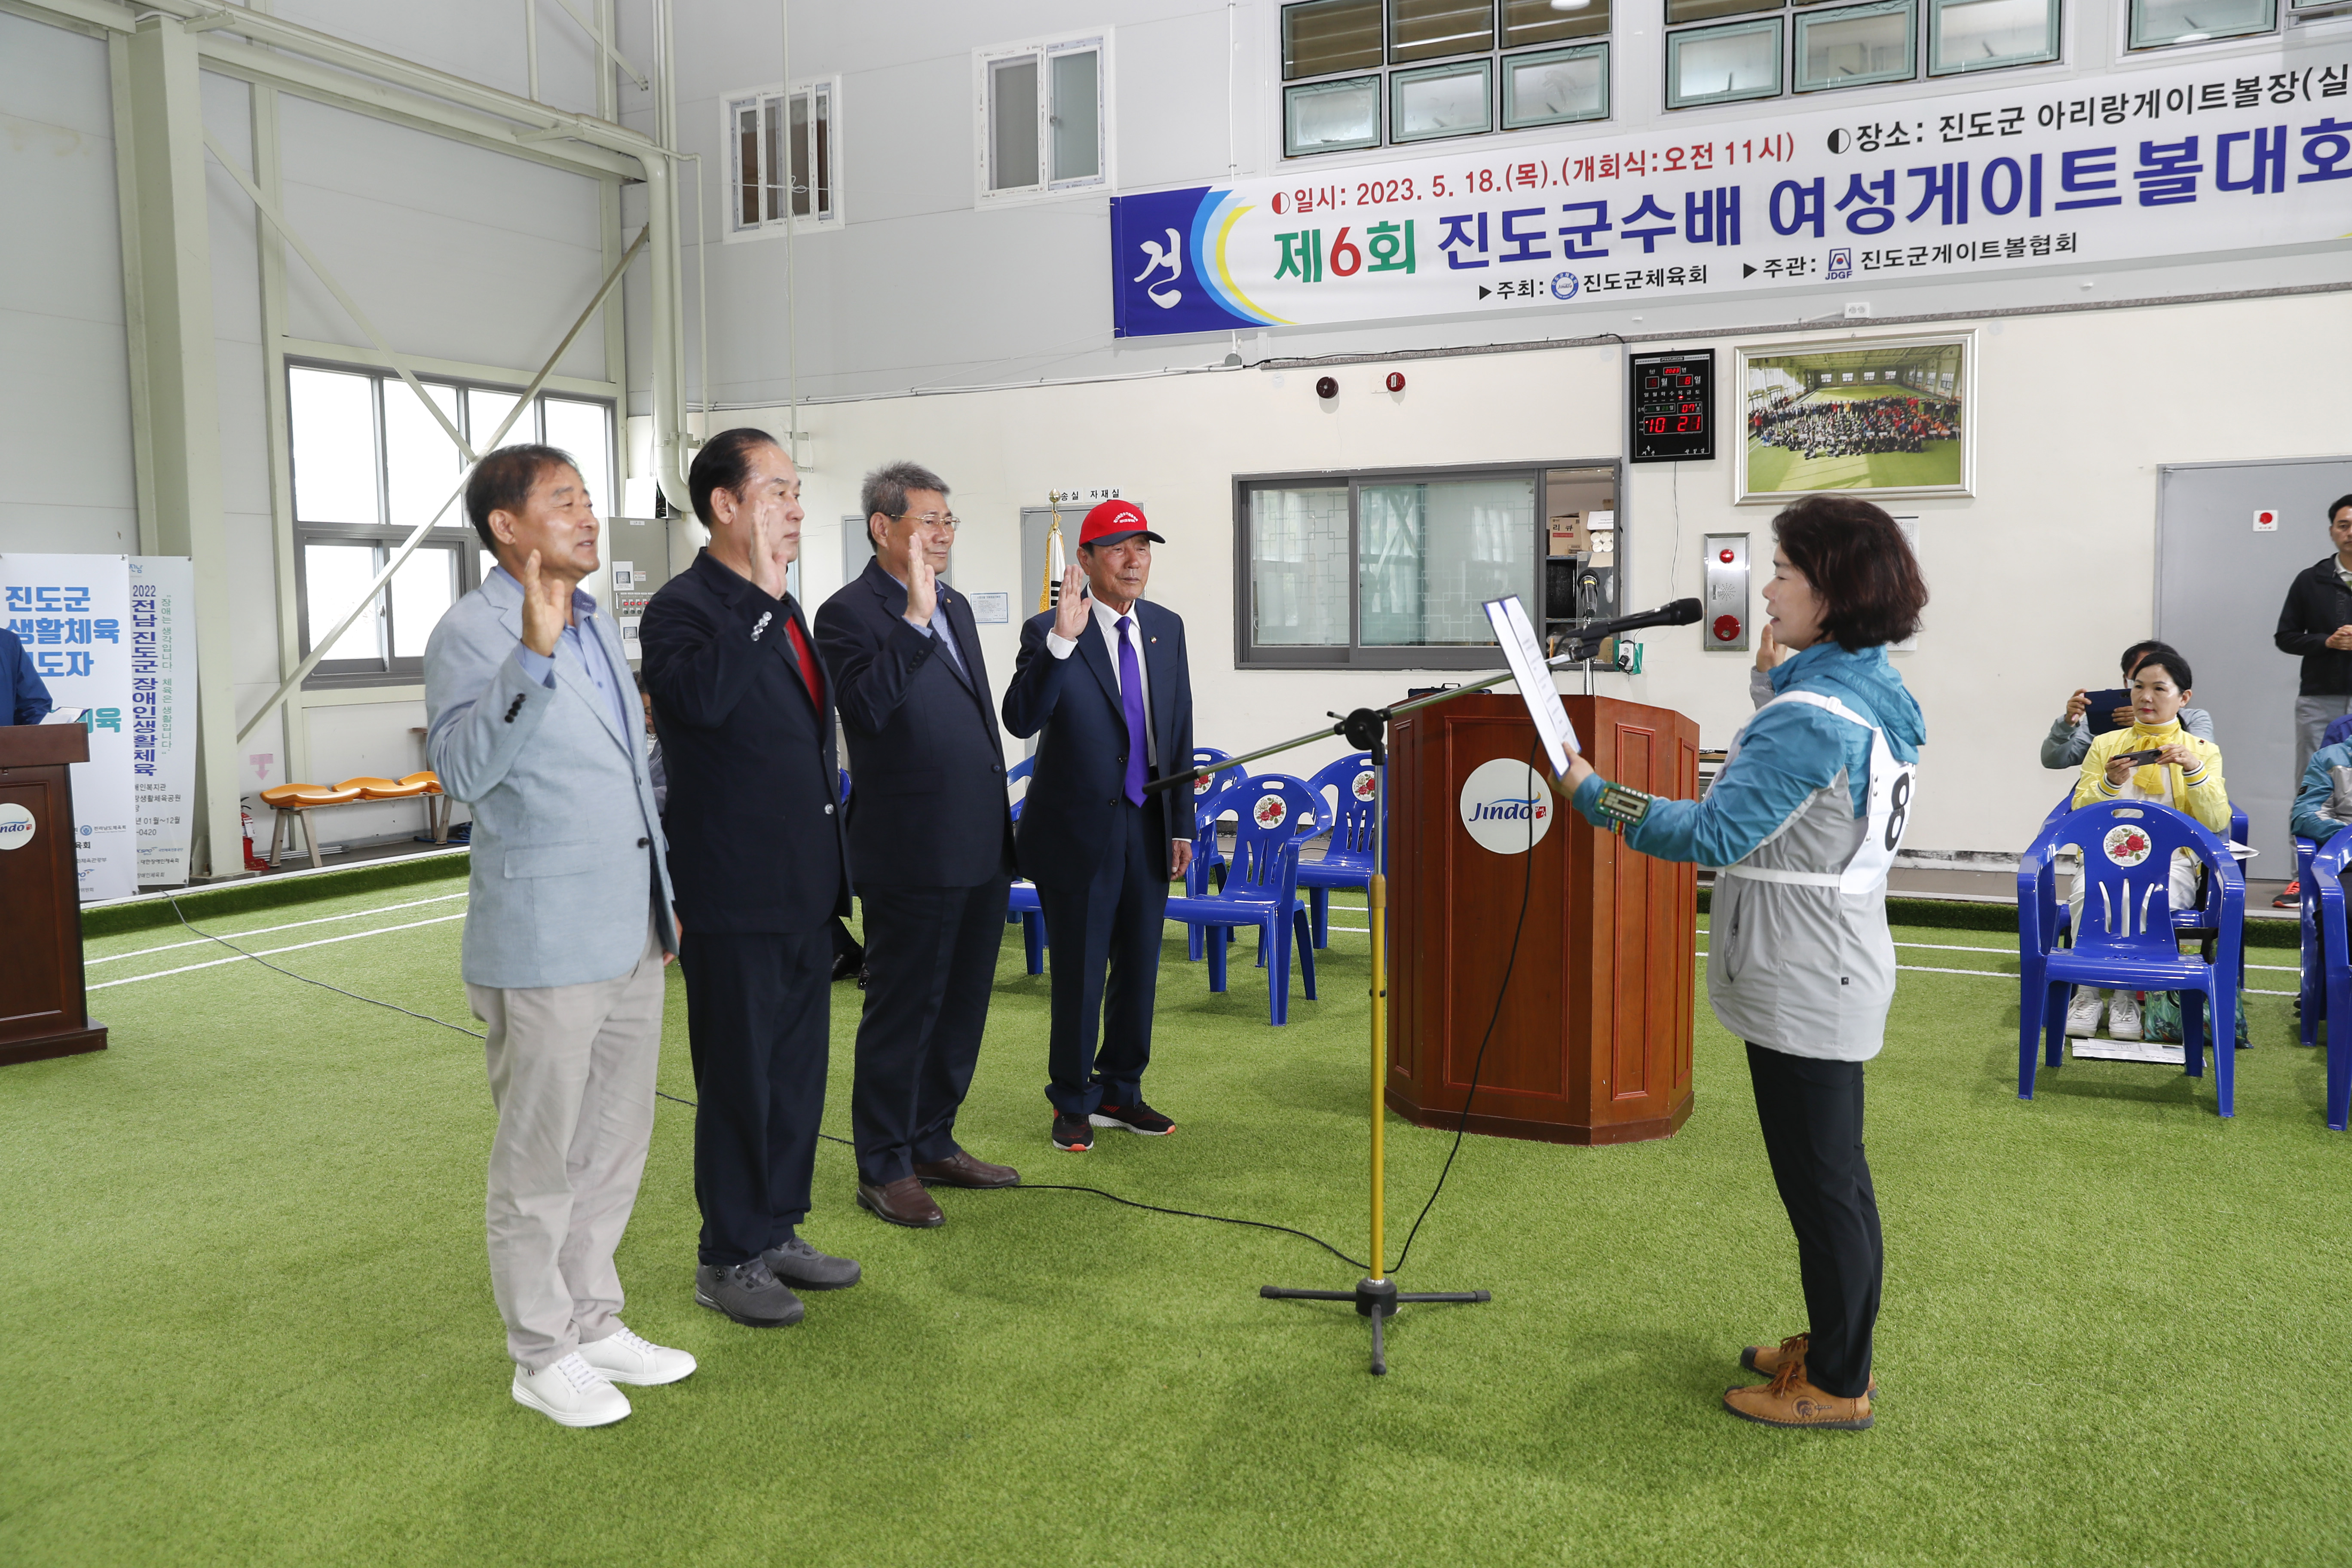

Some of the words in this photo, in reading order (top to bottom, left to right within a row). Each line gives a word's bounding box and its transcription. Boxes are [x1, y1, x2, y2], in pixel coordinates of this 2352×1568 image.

[1856, 122, 1923, 152] 장소:
[1939, 106, 2025, 143] 진도군
[1294, 185, 1346, 213] 일시:
[1357, 178, 1422, 205] 2023.
[1432, 175, 1454, 197] 5.
[1725, 132, 1794, 165] 11시)
[1273, 219, 1416, 283] 제6회
[1438, 185, 1740, 270] 진도군수배
[1763, 257, 1816, 279] 주관:
[1860, 232, 2077, 270] 진도군게이트볼협회
[1497, 279, 1544, 300] 주최:
[1583, 264, 1707, 293] 진도군체육회
[1825, 270, 1853, 280] JDGF
[1649, 417, 1666, 433] 10
[1677, 416, 1701, 432] 21
[6, 586, 91, 612] 진도군
[133, 585, 156, 597] 2022
[6, 618, 120, 644] 생활체육
[132, 600, 158, 627] 전남
[132, 631, 158, 673] 진도군
[132, 677, 159, 776] 장애인생활체육
[1468, 802, 1533, 822] Jindo
[1885, 772, 1909, 851] 8
